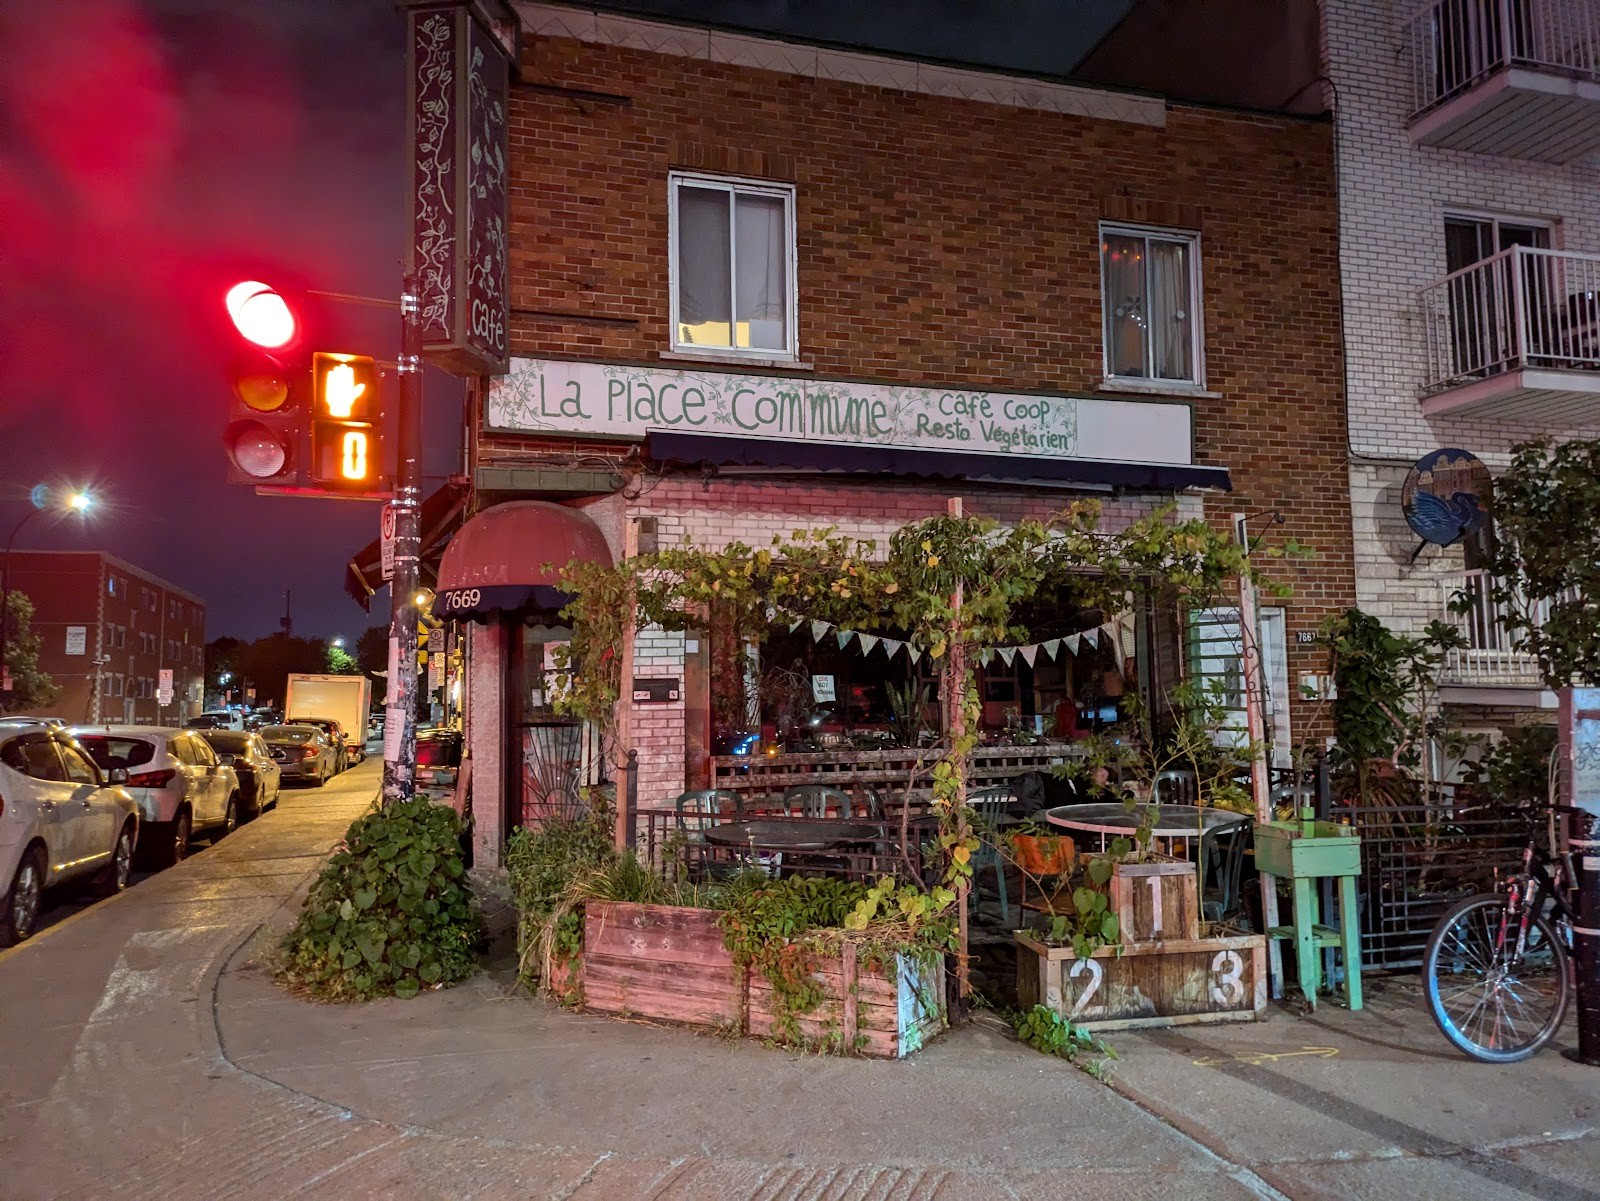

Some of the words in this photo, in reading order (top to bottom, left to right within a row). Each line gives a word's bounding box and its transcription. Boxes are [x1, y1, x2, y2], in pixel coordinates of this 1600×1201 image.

[540, 374, 592, 420] La
[608, 379, 708, 425] Place
[732, 388, 893, 438] Commune
[938, 392, 994, 419] Café
[445, 588, 481, 611] 7669
[1298, 632, 1316, 642] 7667
[1146, 876, 1163, 933] 1
[1069, 959, 1104, 1018] 2
[1211, 950, 1245, 1008] 3
